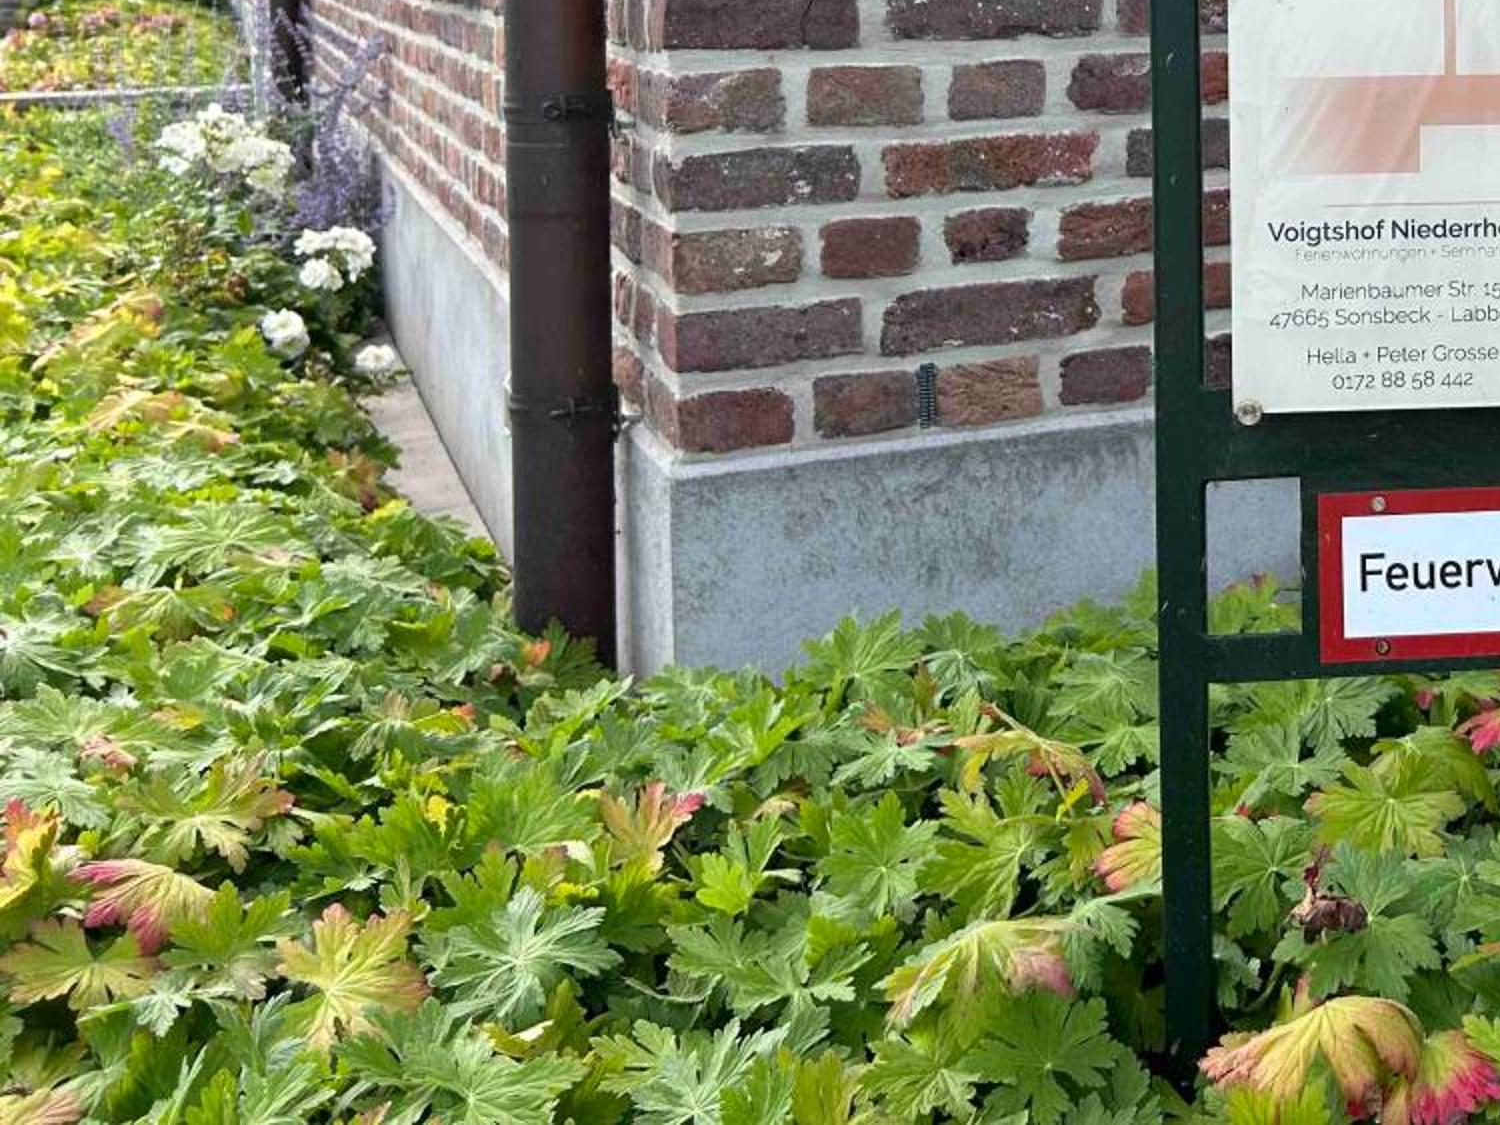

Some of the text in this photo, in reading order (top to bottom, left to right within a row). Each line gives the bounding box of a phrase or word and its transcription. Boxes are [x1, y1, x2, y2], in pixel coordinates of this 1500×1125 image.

[1268, 219, 1384, 246] Voigtshof
[1301, 282, 1443, 300] Marienbaumer
[1269, 311, 1329, 328] 47665
[1335, 306, 1431, 326] Sonsbeck
[1377, 345, 1426, 363] Peter
[1433, 344, 1499, 361] Grosse
[1332, 371, 1473, 391] 0172 88 58 442
